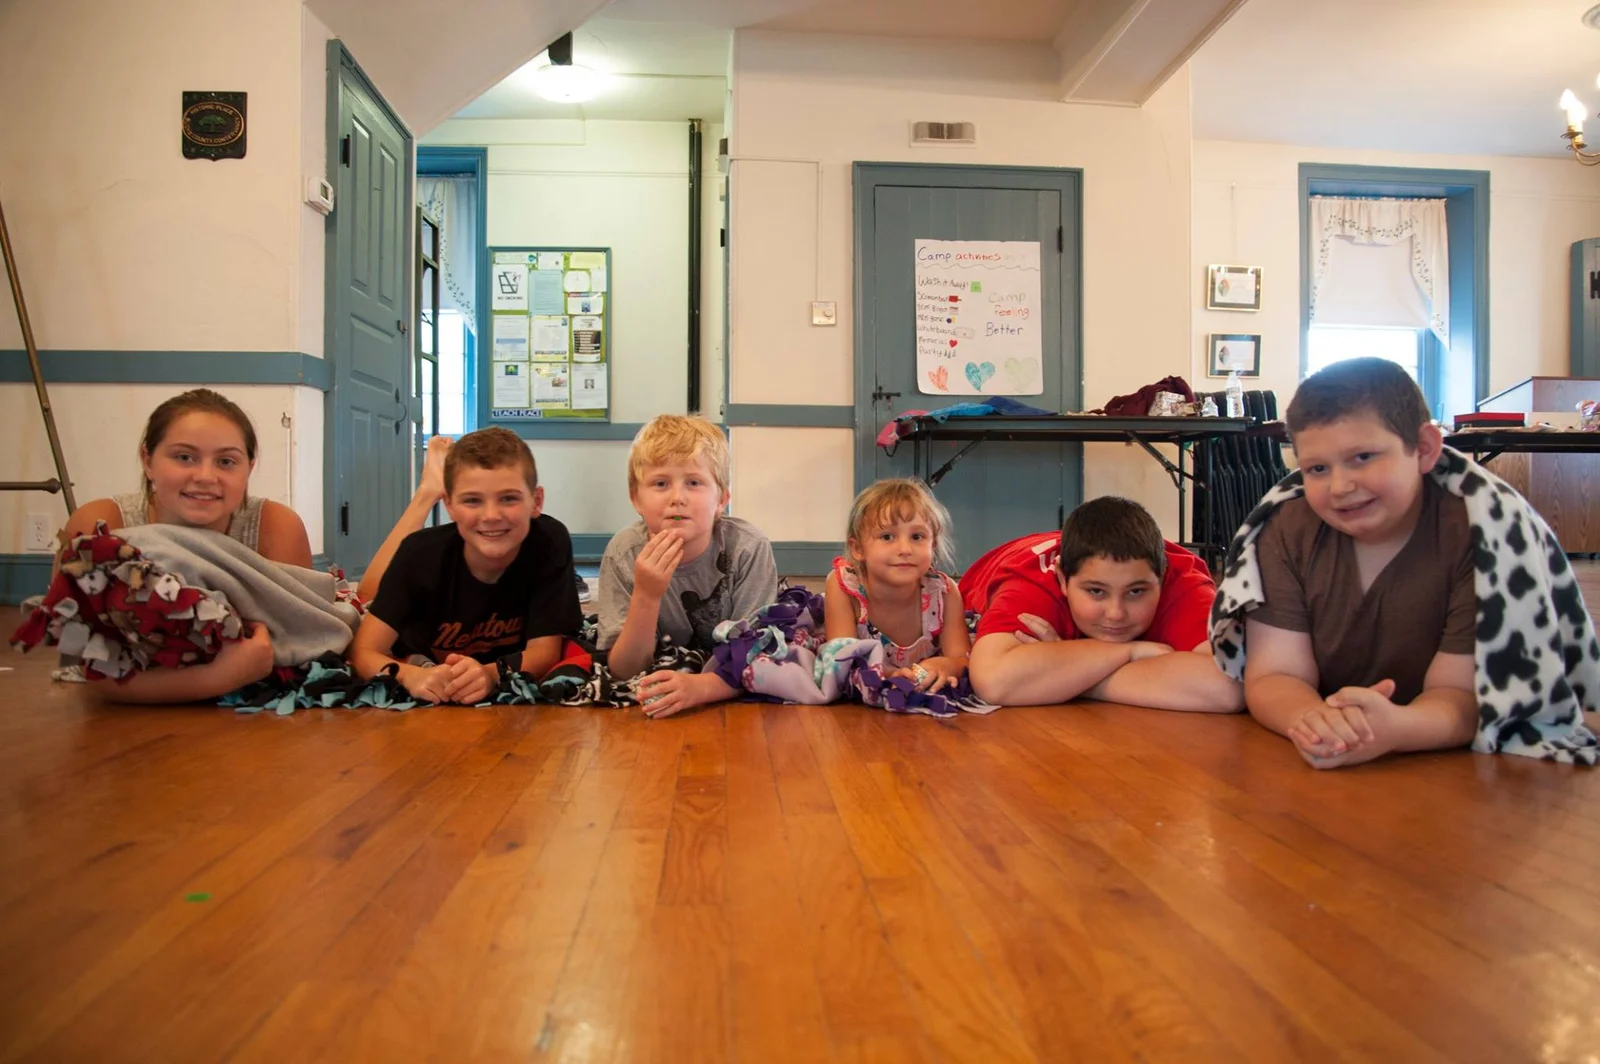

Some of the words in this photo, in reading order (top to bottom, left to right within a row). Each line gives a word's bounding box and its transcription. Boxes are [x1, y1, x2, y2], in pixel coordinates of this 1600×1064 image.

[917, 246, 951, 261] Camp
[955, 252, 1001, 261] activities
[918, 275, 941, 287] Wash
[988, 292, 1026, 304] Camp
[985, 321, 1024, 337] Better
[493, 409, 518, 417] TEACH
